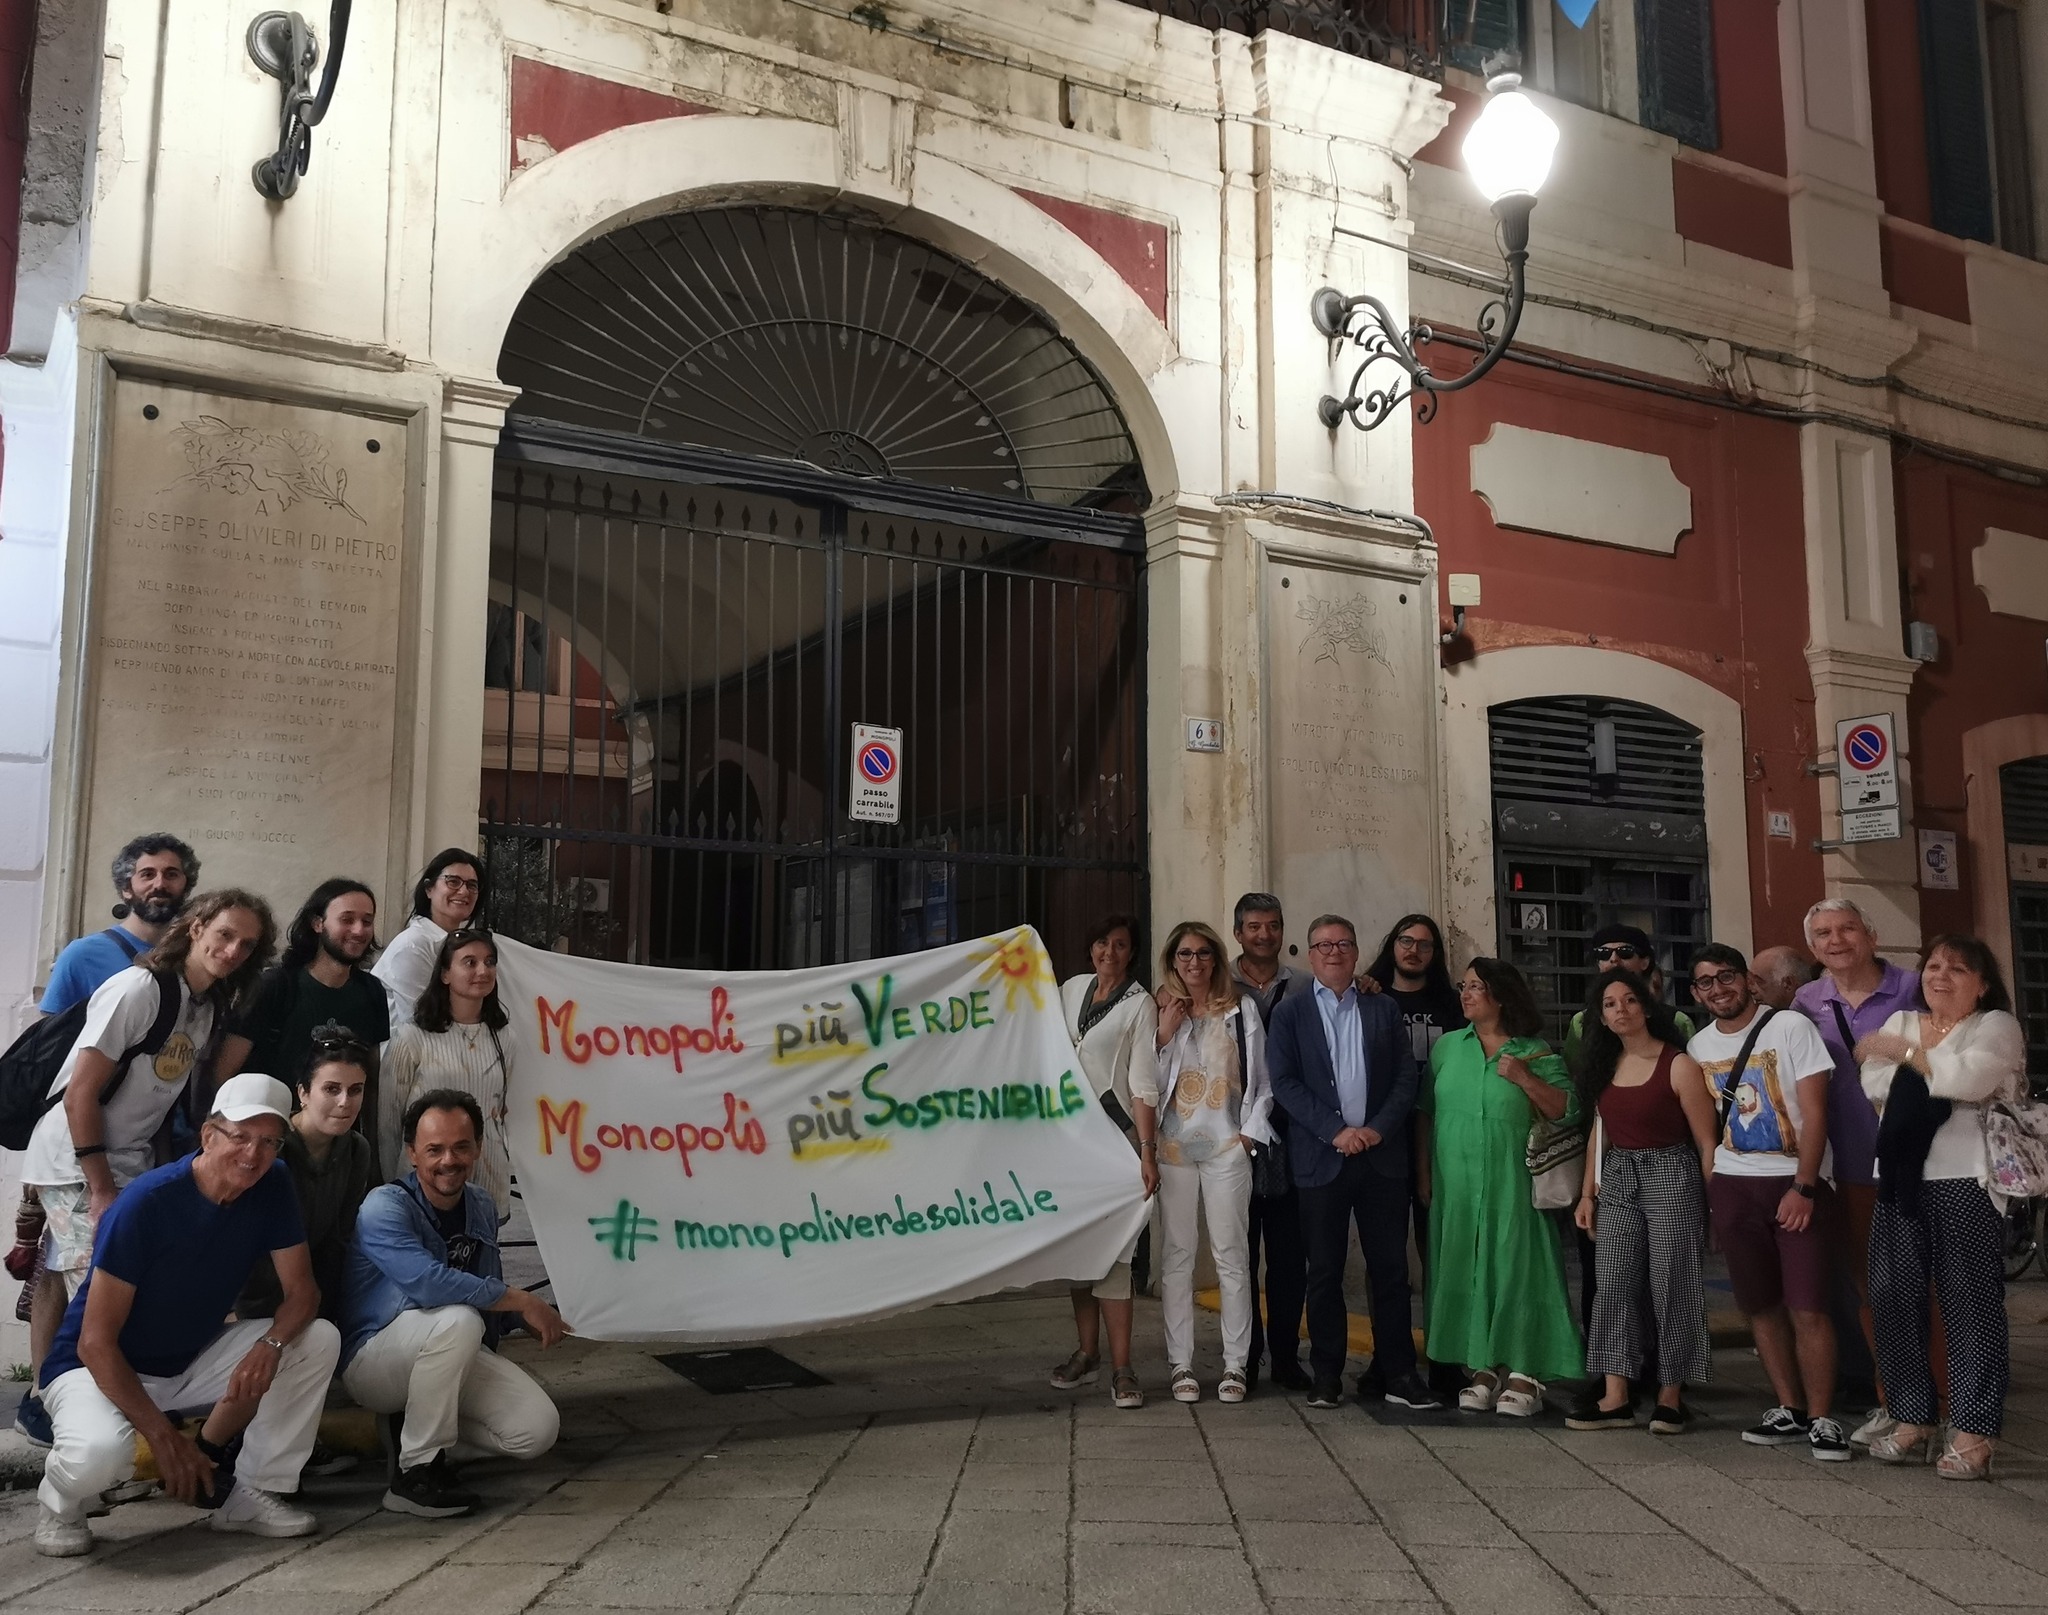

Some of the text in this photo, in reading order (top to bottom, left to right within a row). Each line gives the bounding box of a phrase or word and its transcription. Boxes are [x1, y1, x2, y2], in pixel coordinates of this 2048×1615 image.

[255, 499, 268, 516] A
[218, 521, 303, 549] OLIVIERI
[311, 533, 327, 552] DI
[335, 536, 398, 561] PIETRO
[138, 579, 160, 592] NEL
[248, 651, 282, 664] MORTE
[1195, 722, 1204, 740] 6
[863, 788, 889, 797] passo
[856, 798, 895, 810] carrabile
[536, 985, 745, 1075] Monopoli
[851, 973, 995, 1047] VERDE
[861, 1061, 1086, 1130] SOSTENIBILE
